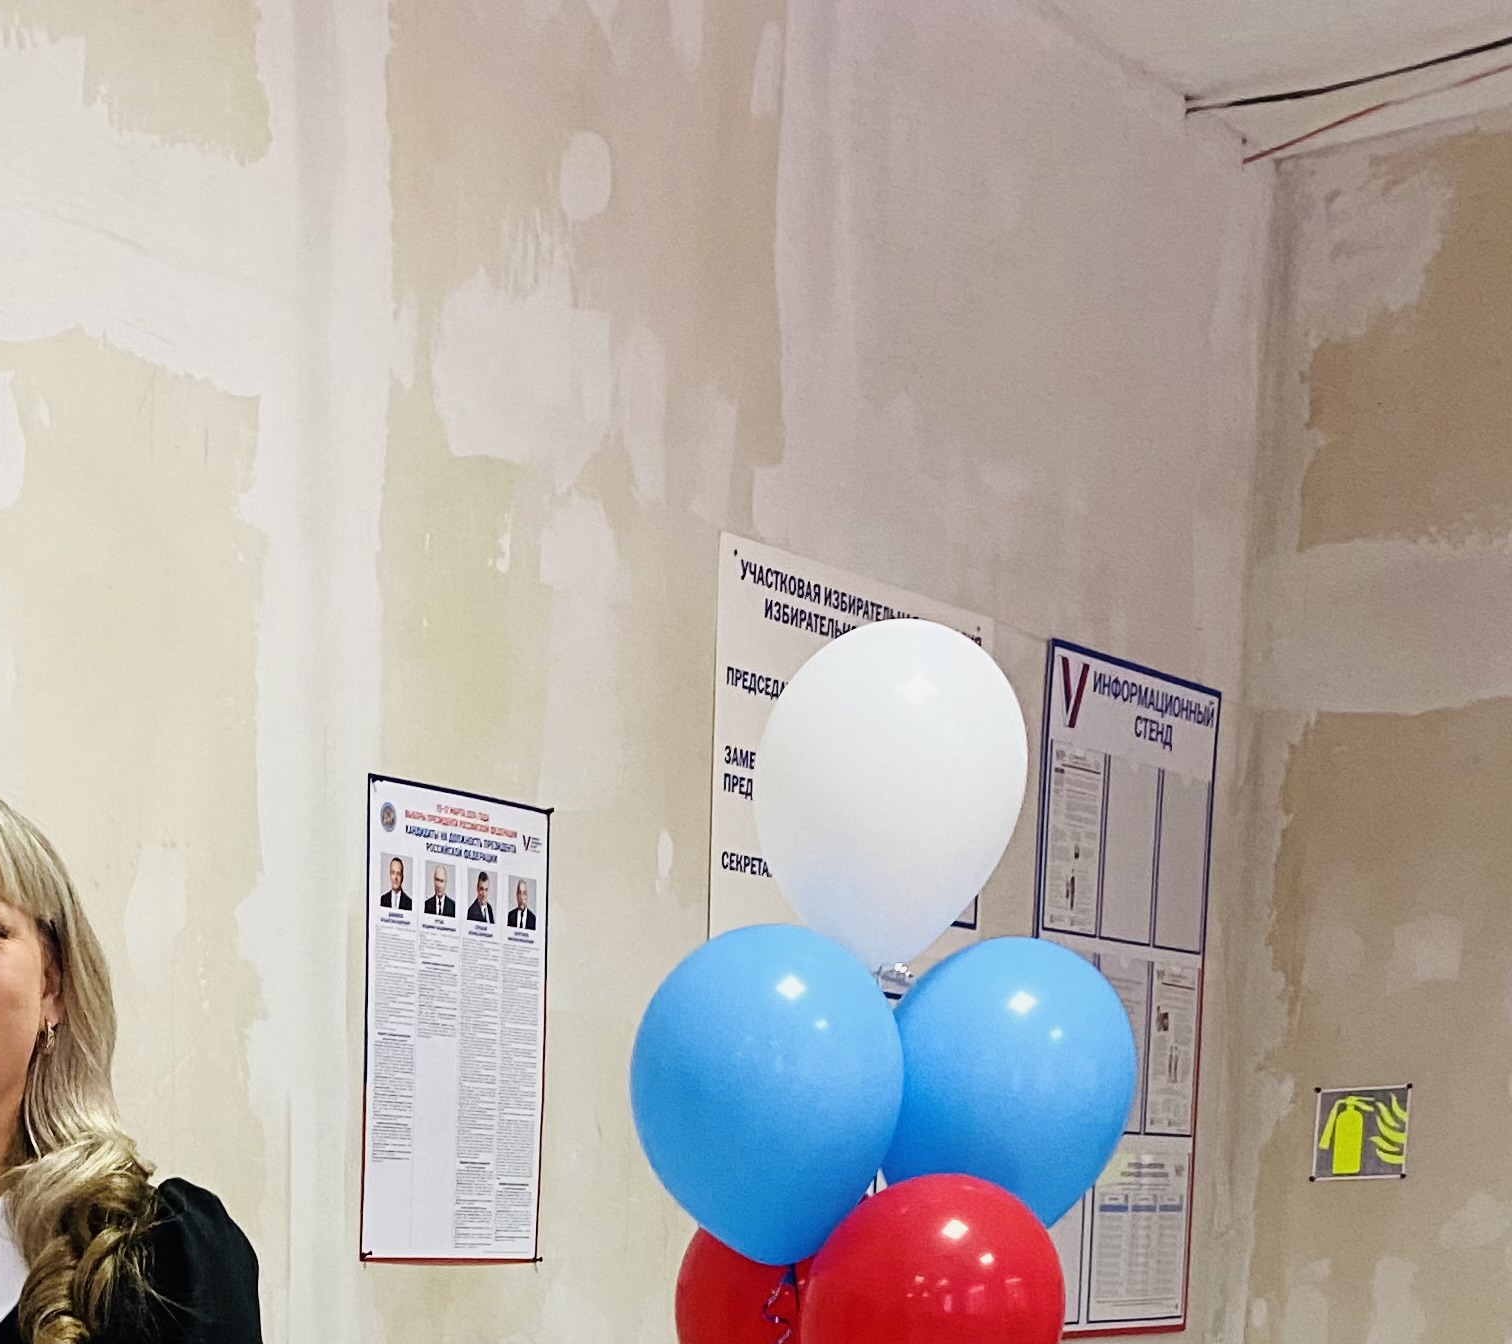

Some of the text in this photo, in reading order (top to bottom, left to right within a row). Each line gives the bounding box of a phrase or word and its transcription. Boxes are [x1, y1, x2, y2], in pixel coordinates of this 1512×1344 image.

[740, 559, 919, 621] УЧАСТКОВАЯ ИЗБИРАТЕЛЬ
[726, 666, 789, 701] ПРЕДСЕДА
[1093, 670, 1215, 728] ИНФОРМАЦИОННЫЙ
[1134, 716, 1173, 751] СТЕНД
[721, 851, 773, 878] СЕКРЕТА
